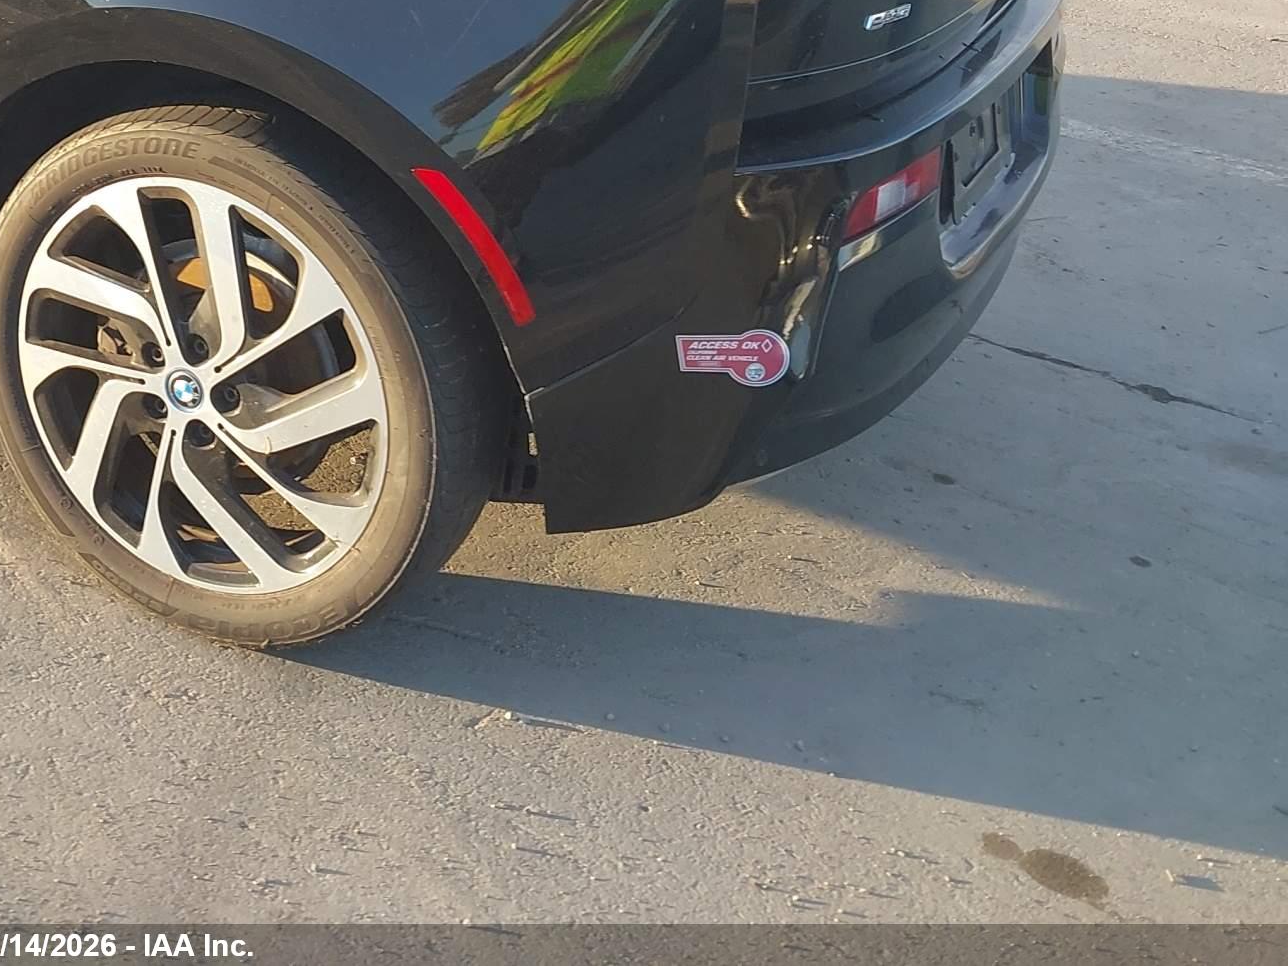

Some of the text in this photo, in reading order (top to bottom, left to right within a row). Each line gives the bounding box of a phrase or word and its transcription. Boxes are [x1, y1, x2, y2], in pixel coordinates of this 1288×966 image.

[31, 136, 201, 204] BRIDGESTONE
[688, 341, 762, 350] ACCESS OK
